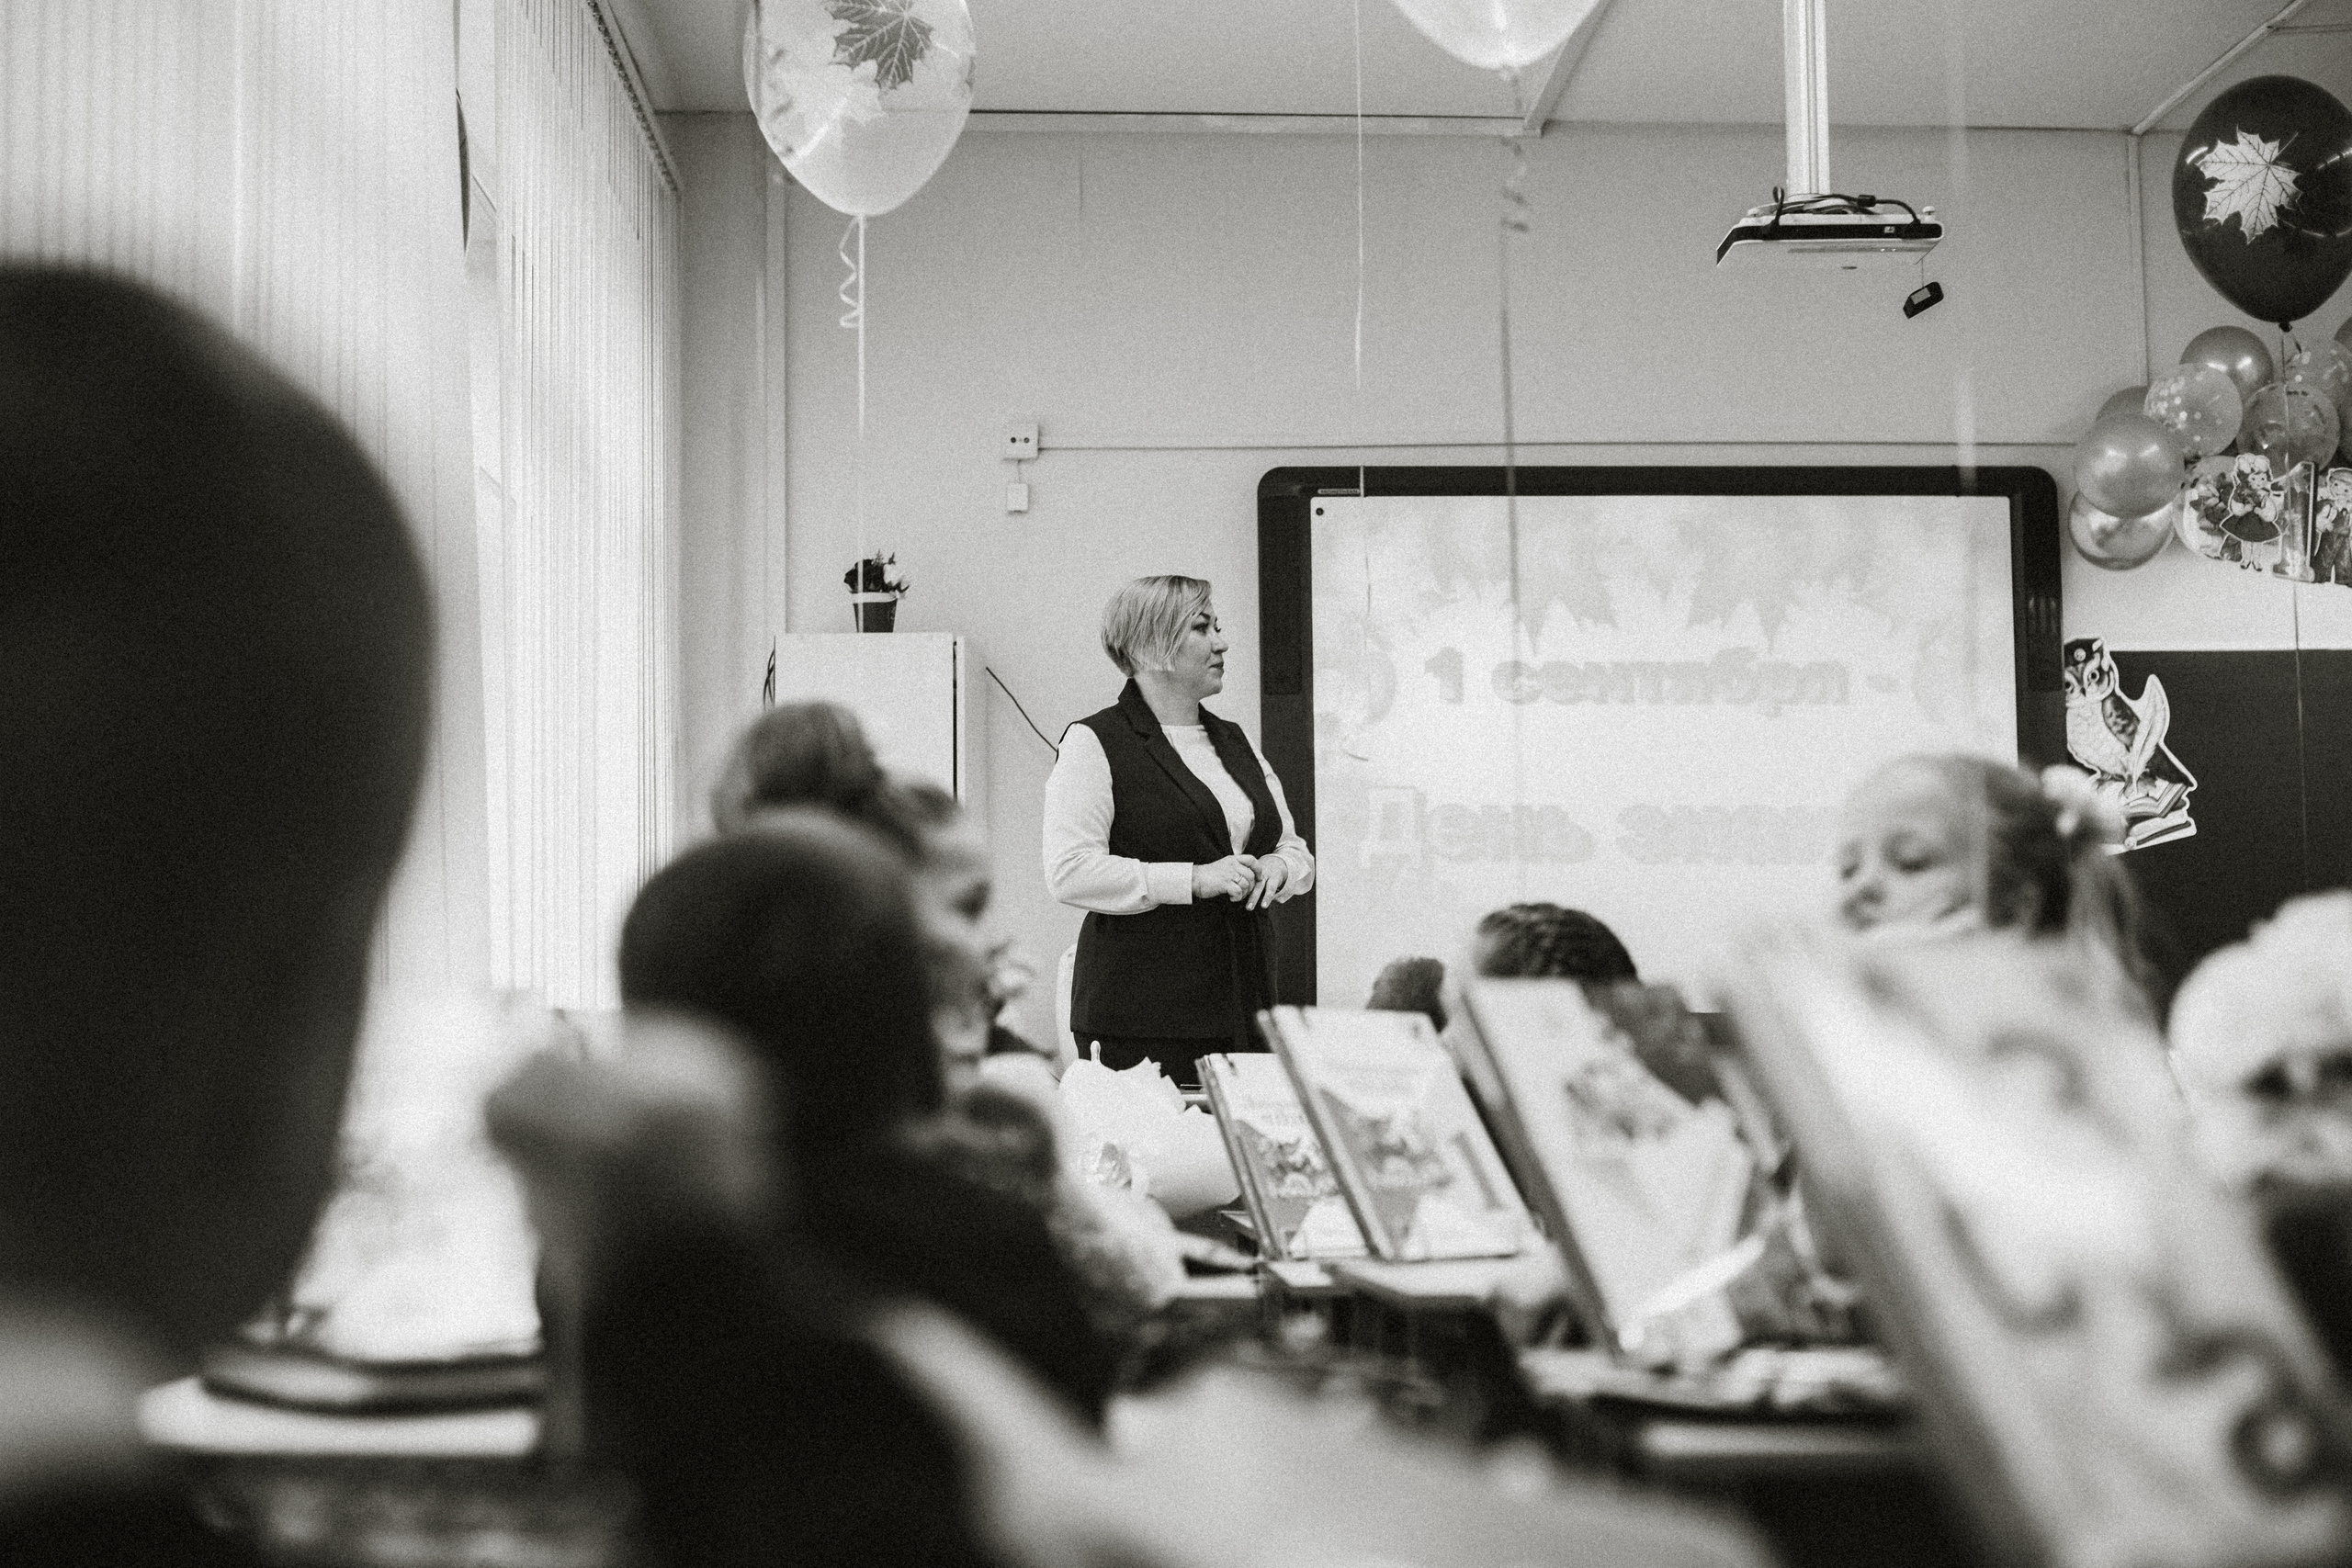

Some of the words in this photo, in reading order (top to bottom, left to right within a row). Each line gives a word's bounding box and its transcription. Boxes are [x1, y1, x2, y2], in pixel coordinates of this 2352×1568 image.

[1423, 646, 1465, 705] 1
[1491, 646, 1849, 719] сентября
[1360, 786, 1596, 871] День
[1615, 802, 1841, 865] знан
